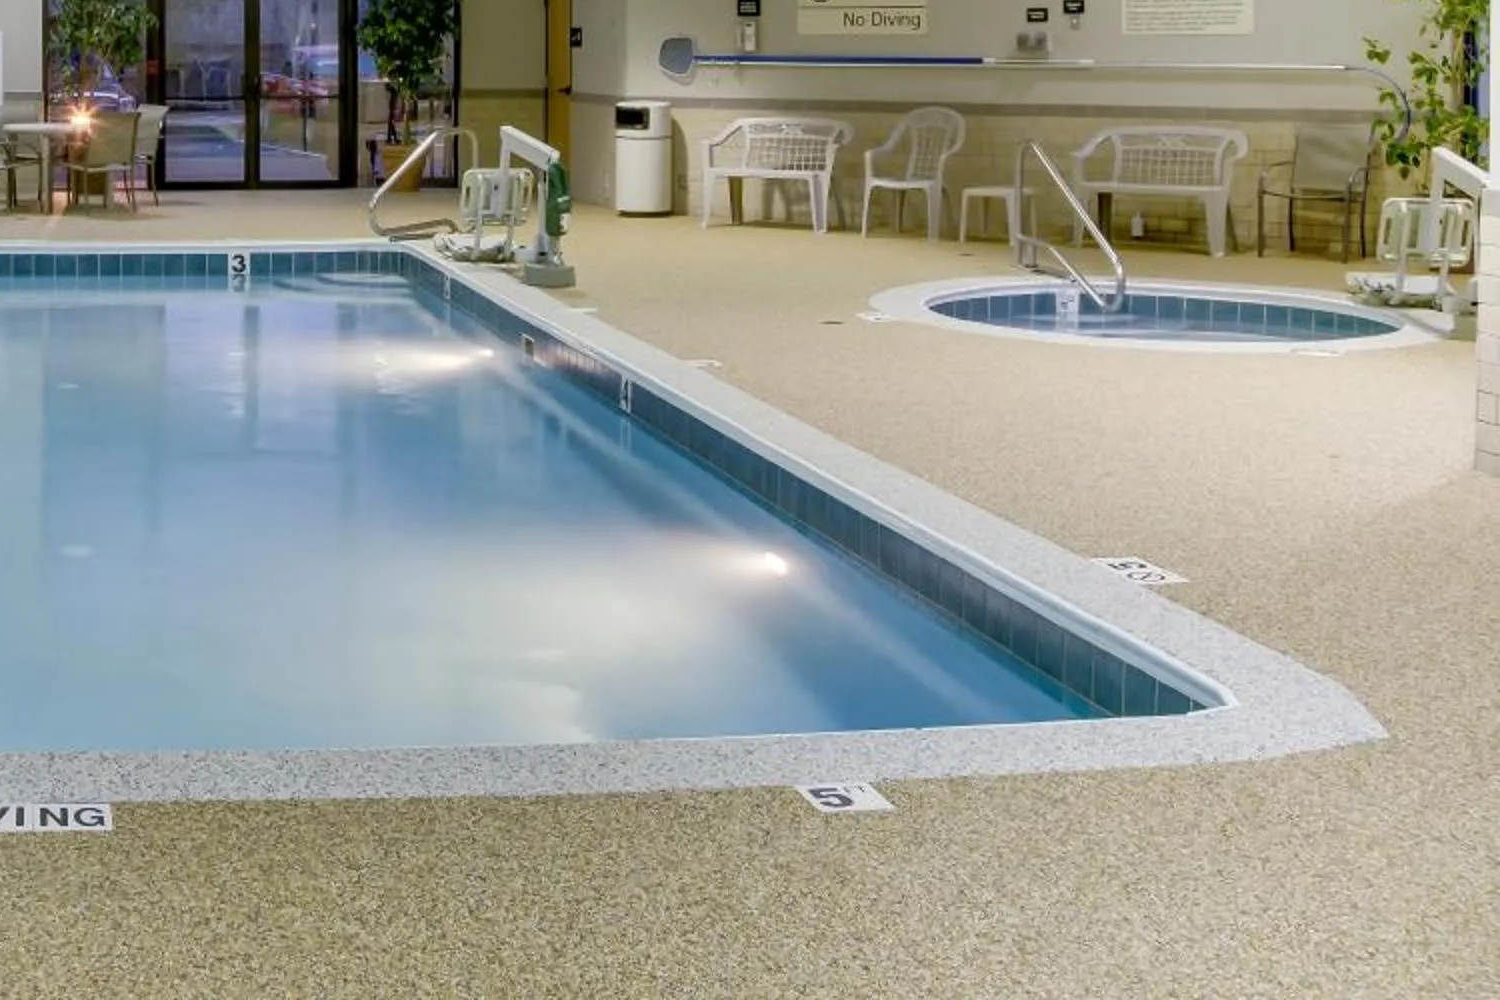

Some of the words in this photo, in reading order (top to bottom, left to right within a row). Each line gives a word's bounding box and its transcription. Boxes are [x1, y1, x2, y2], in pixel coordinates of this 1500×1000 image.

[843, 12, 865, 27] No
[871, 11, 922, 30] Diving
[232, 254, 247, 273] 3
[808, 787, 854, 807] 5
